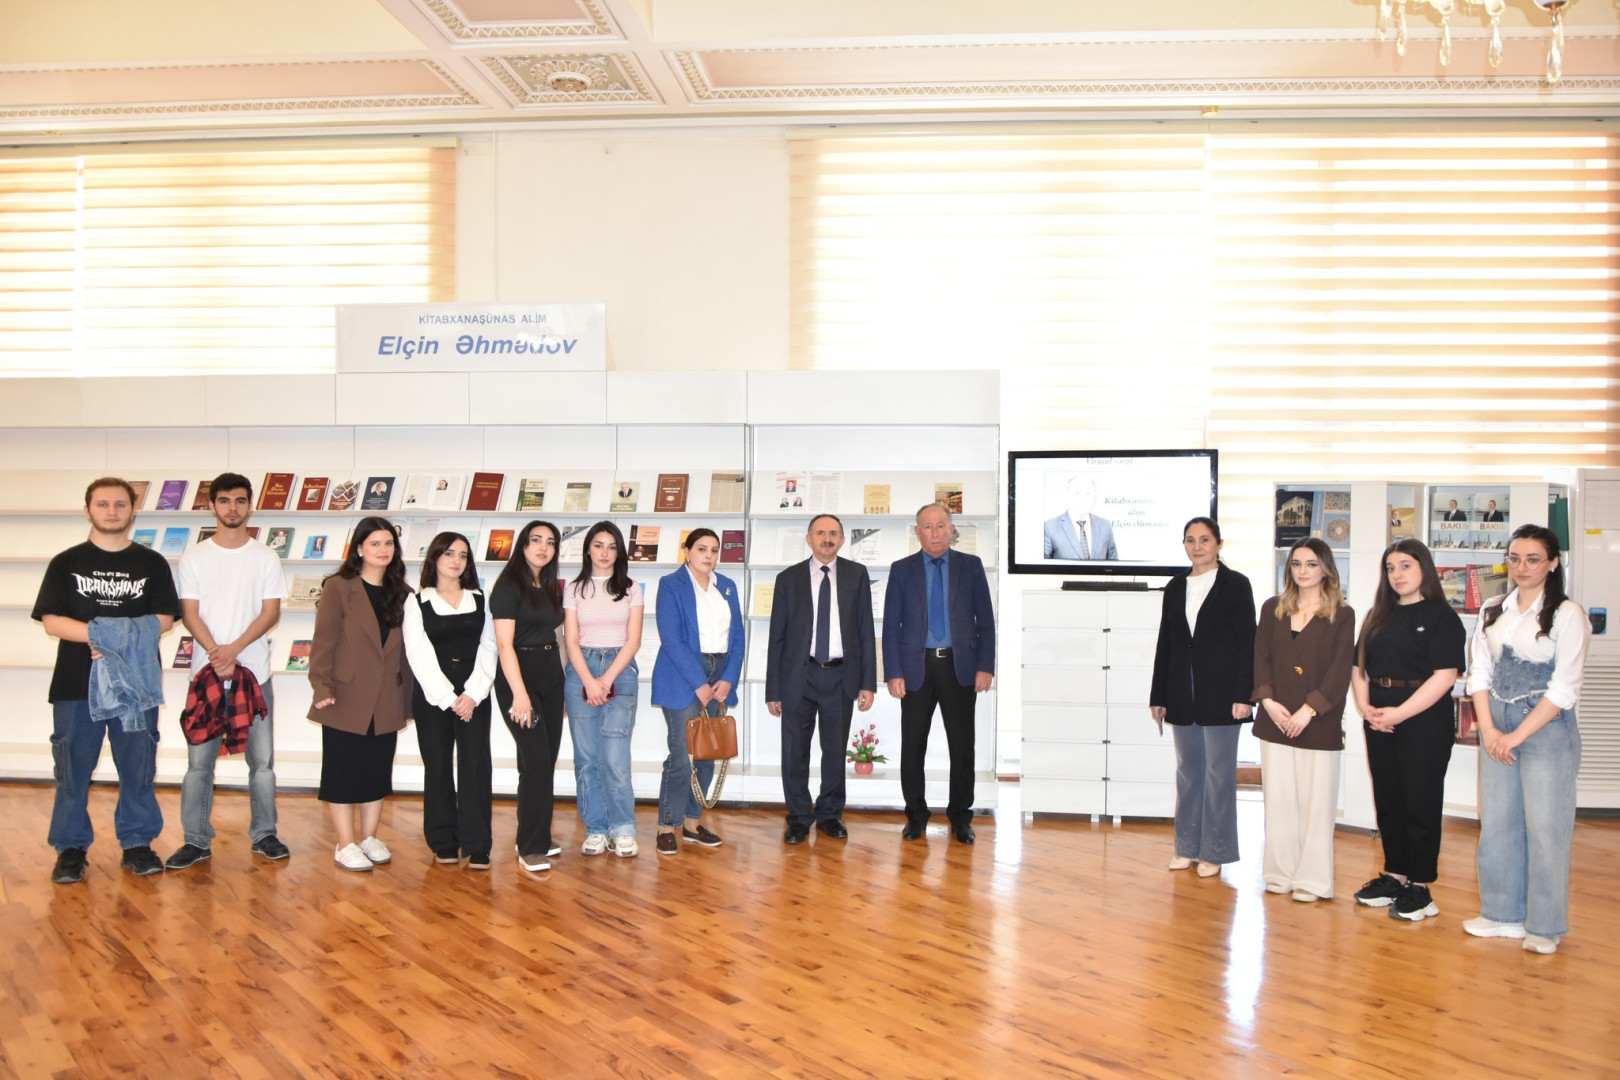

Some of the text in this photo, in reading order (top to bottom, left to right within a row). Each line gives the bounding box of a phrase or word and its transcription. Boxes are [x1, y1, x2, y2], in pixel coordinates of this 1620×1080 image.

[418, 312, 547, 326] KİTABXANAŞÜNAS ALİM
[377, 335, 440, 360] Elçin
[70, 572, 149, 600] DEADSHINE
